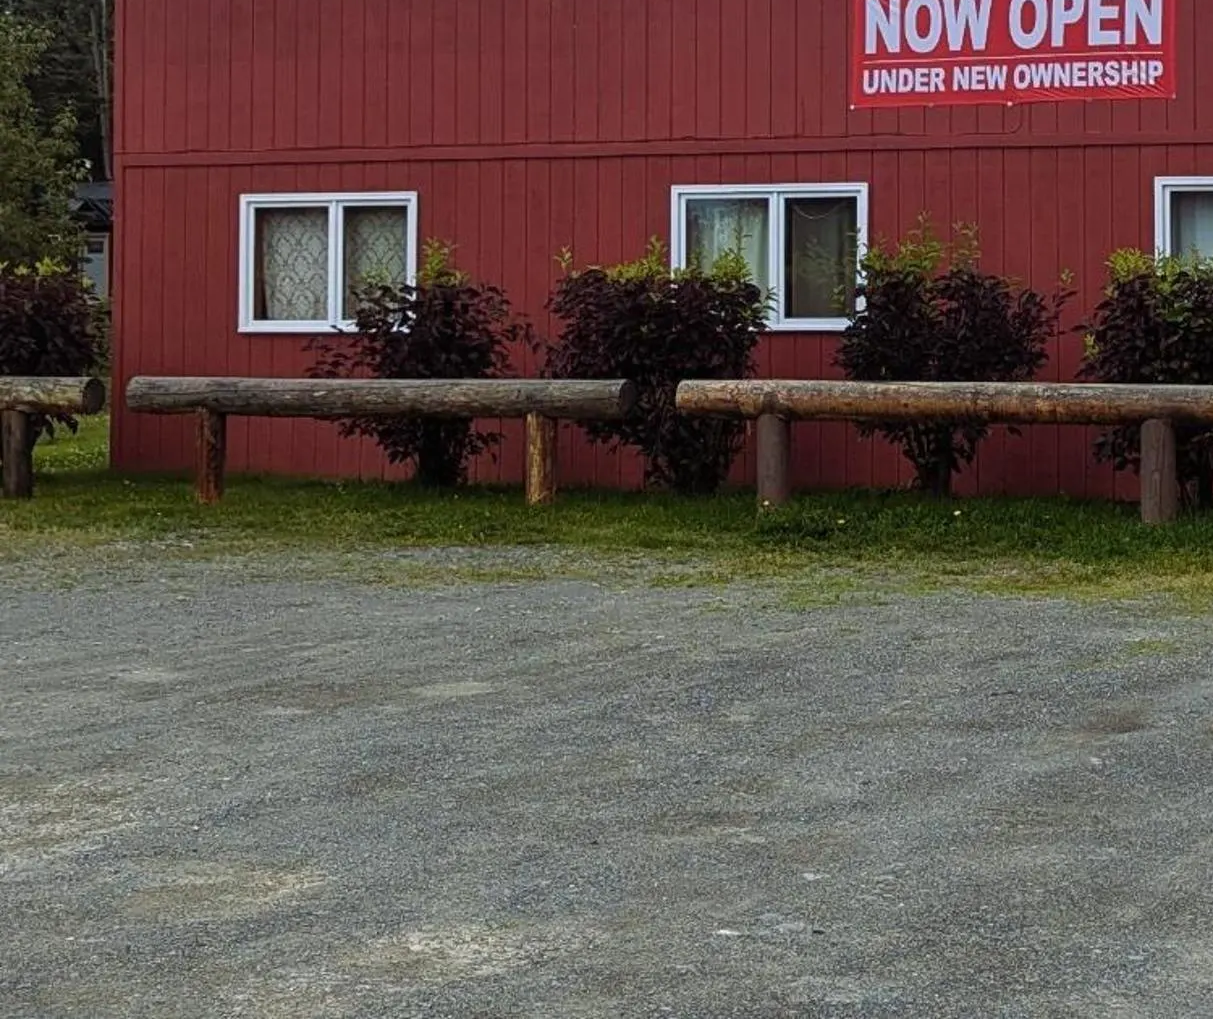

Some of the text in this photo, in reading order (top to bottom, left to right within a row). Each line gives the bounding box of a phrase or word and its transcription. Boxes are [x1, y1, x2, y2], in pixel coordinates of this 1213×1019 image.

[862, 59, 1164, 95] UNDER NEW OWNERSHIP
